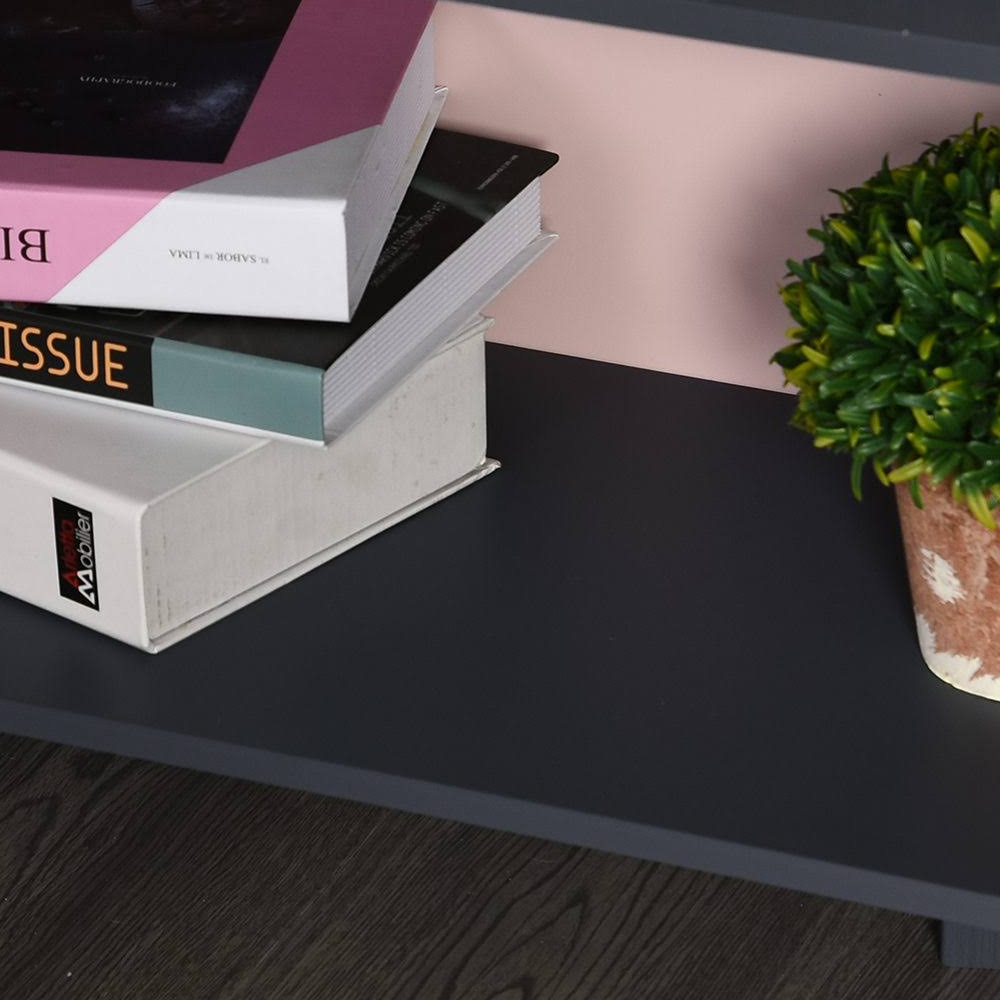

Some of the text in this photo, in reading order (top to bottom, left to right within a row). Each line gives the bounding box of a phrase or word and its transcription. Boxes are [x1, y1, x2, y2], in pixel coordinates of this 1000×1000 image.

[168, 249, 200, 260] LIMA
[215, 252, 257, 263] SABOR
[76, 511, 96, 605] Mobilier
